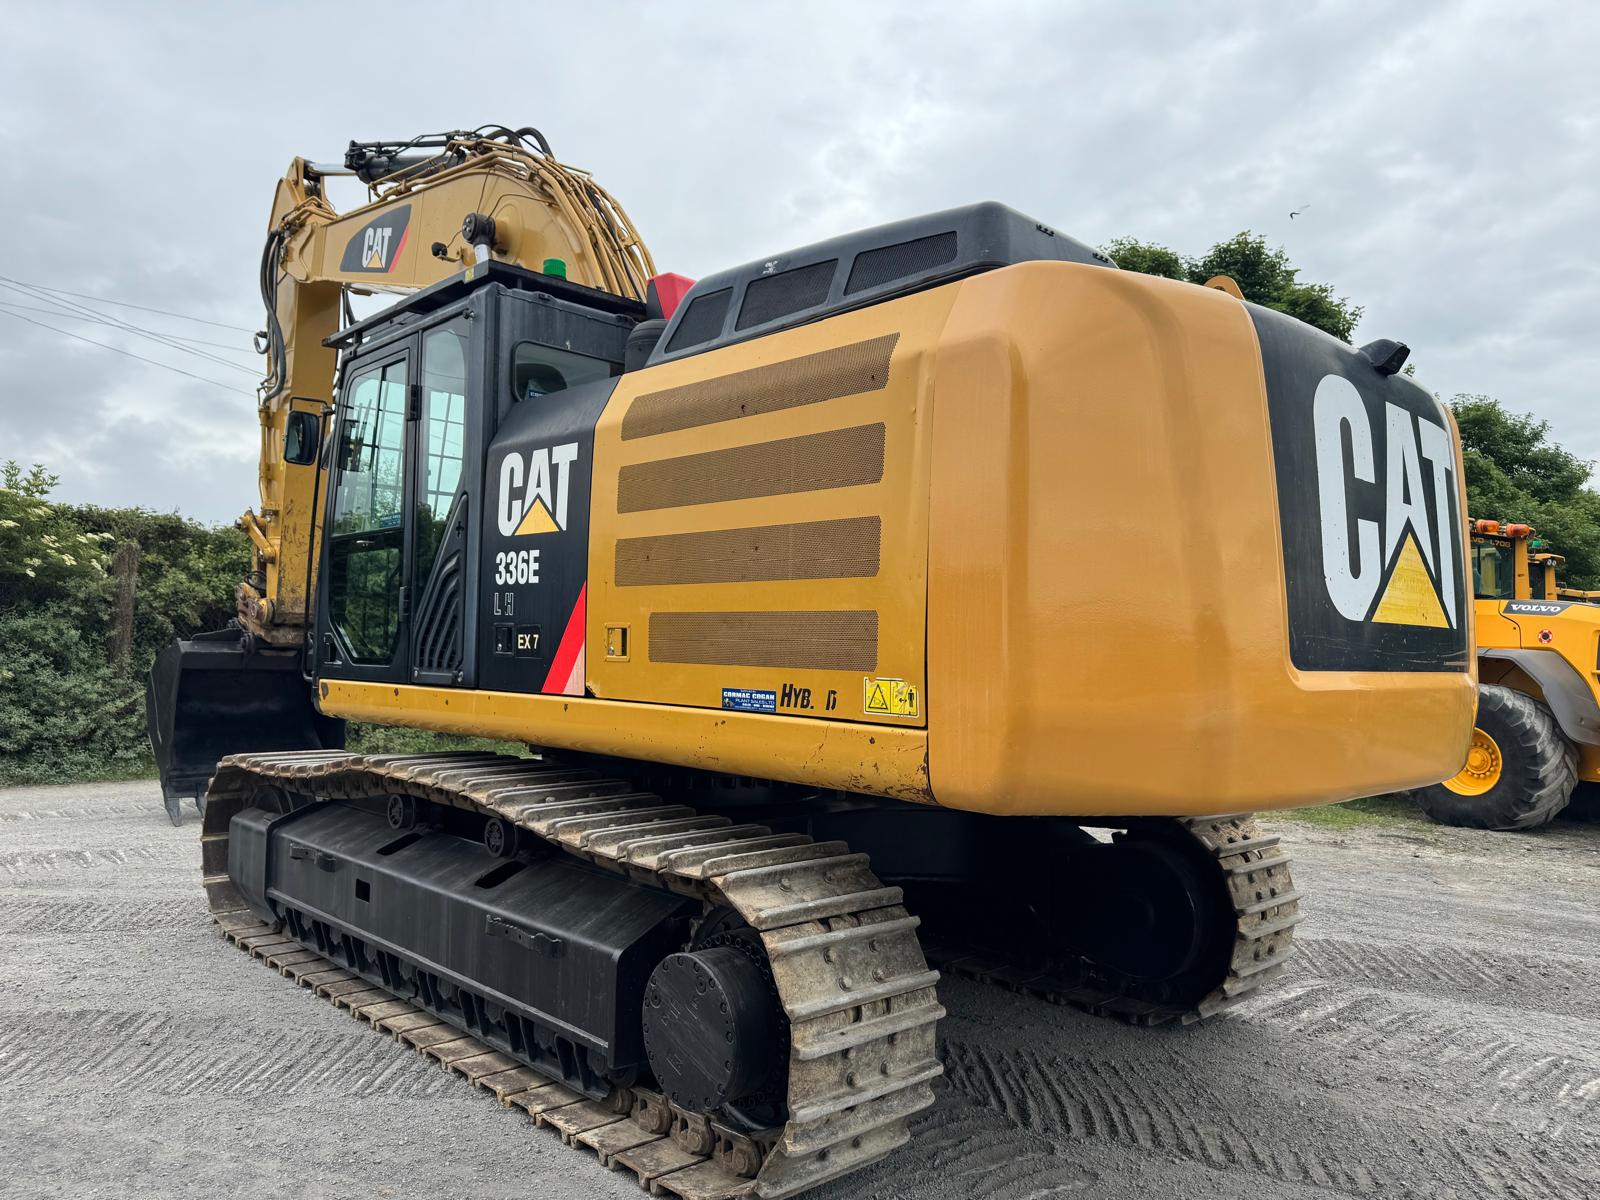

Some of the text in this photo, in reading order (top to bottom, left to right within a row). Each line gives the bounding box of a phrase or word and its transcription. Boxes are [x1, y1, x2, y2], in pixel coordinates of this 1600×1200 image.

[362, 227, 392, 268] CAT
[497, 442, 578, 536] CAT
[1313, 374, 1457, 629] CAT
[495, 549, 540, 585] 336E
[1510, 604, 1561, 613] VOLVO
[517, 634, 539, 649] EX 7
[723, 691, 751, 699] CORMAC
[752, 693, 775, 701] COGAN
